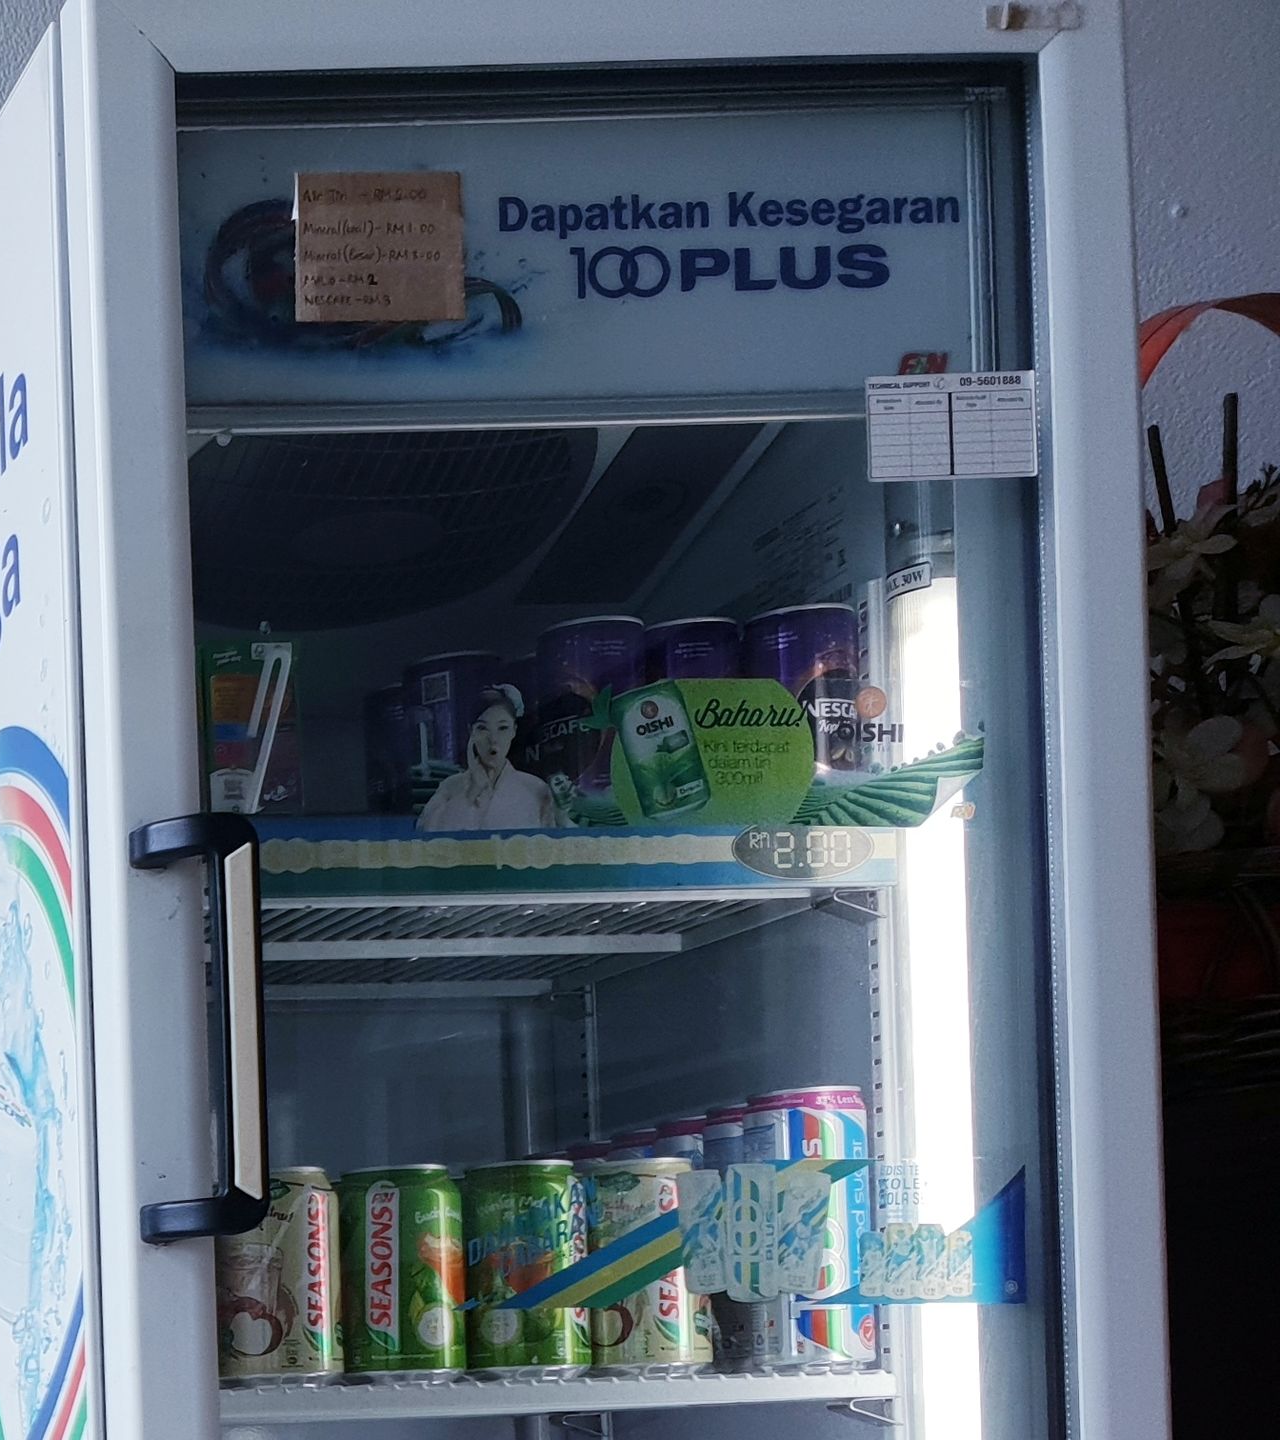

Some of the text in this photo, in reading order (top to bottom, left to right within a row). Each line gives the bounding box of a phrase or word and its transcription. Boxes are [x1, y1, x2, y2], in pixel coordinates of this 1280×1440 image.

[498, 192, 961, 239] Dapatkan Kesegaran
[903, 381, 931, 389] SUPPORT
[959, 375, 1022, 387] 09-5601888
[636, 716, 675, 736] OISHI
[694, 698, 810, 729] Baharu!
[773, 831, 851, 868] 2.00
[370, 1204, 393, 1328] SEASONS
